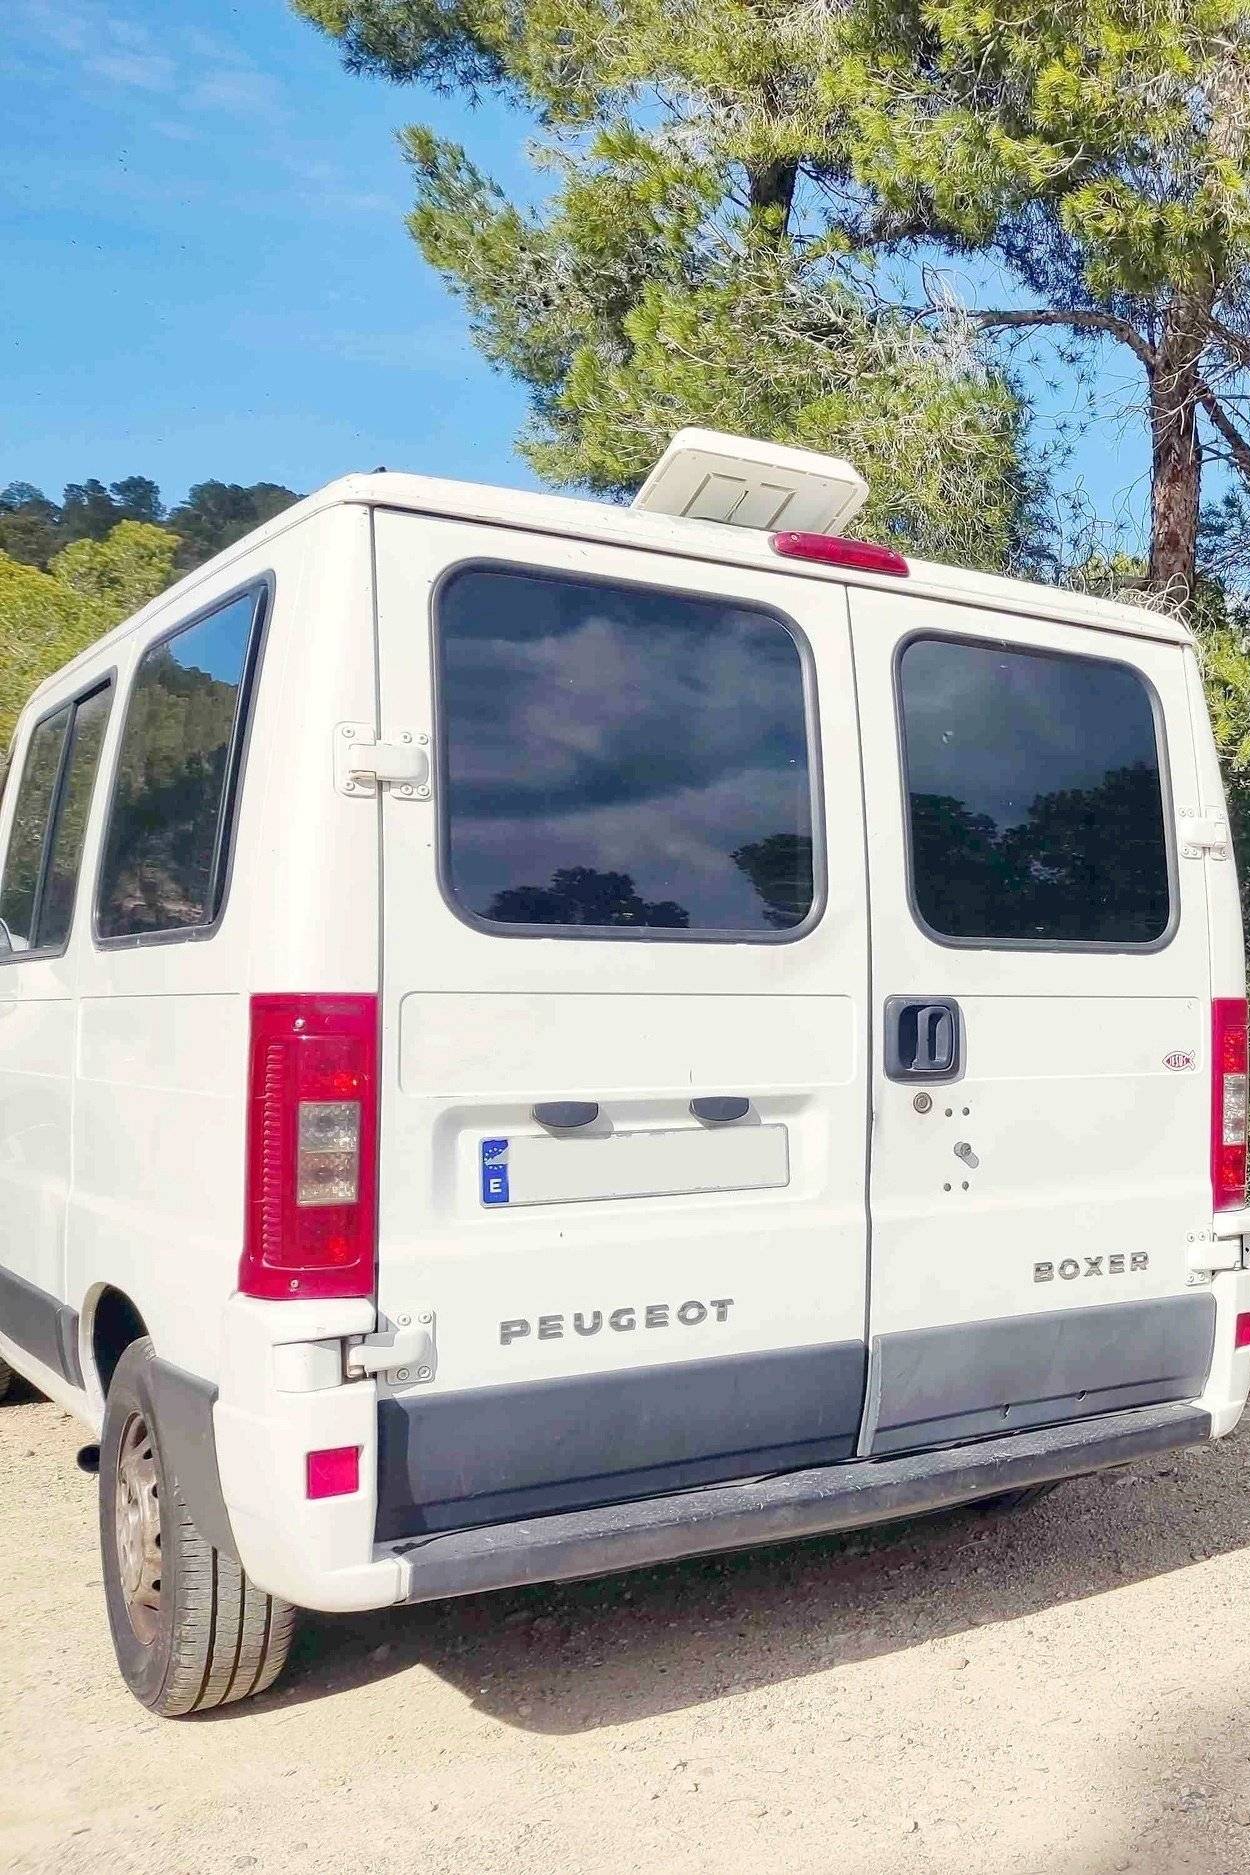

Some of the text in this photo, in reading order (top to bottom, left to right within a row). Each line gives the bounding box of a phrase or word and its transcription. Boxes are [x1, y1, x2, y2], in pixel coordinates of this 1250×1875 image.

[489, 1178, 502, 1193] E
[1033, 1251, 1149, 1283] BOXER
[500, 1298, 734, 1345] PEUGEOT
